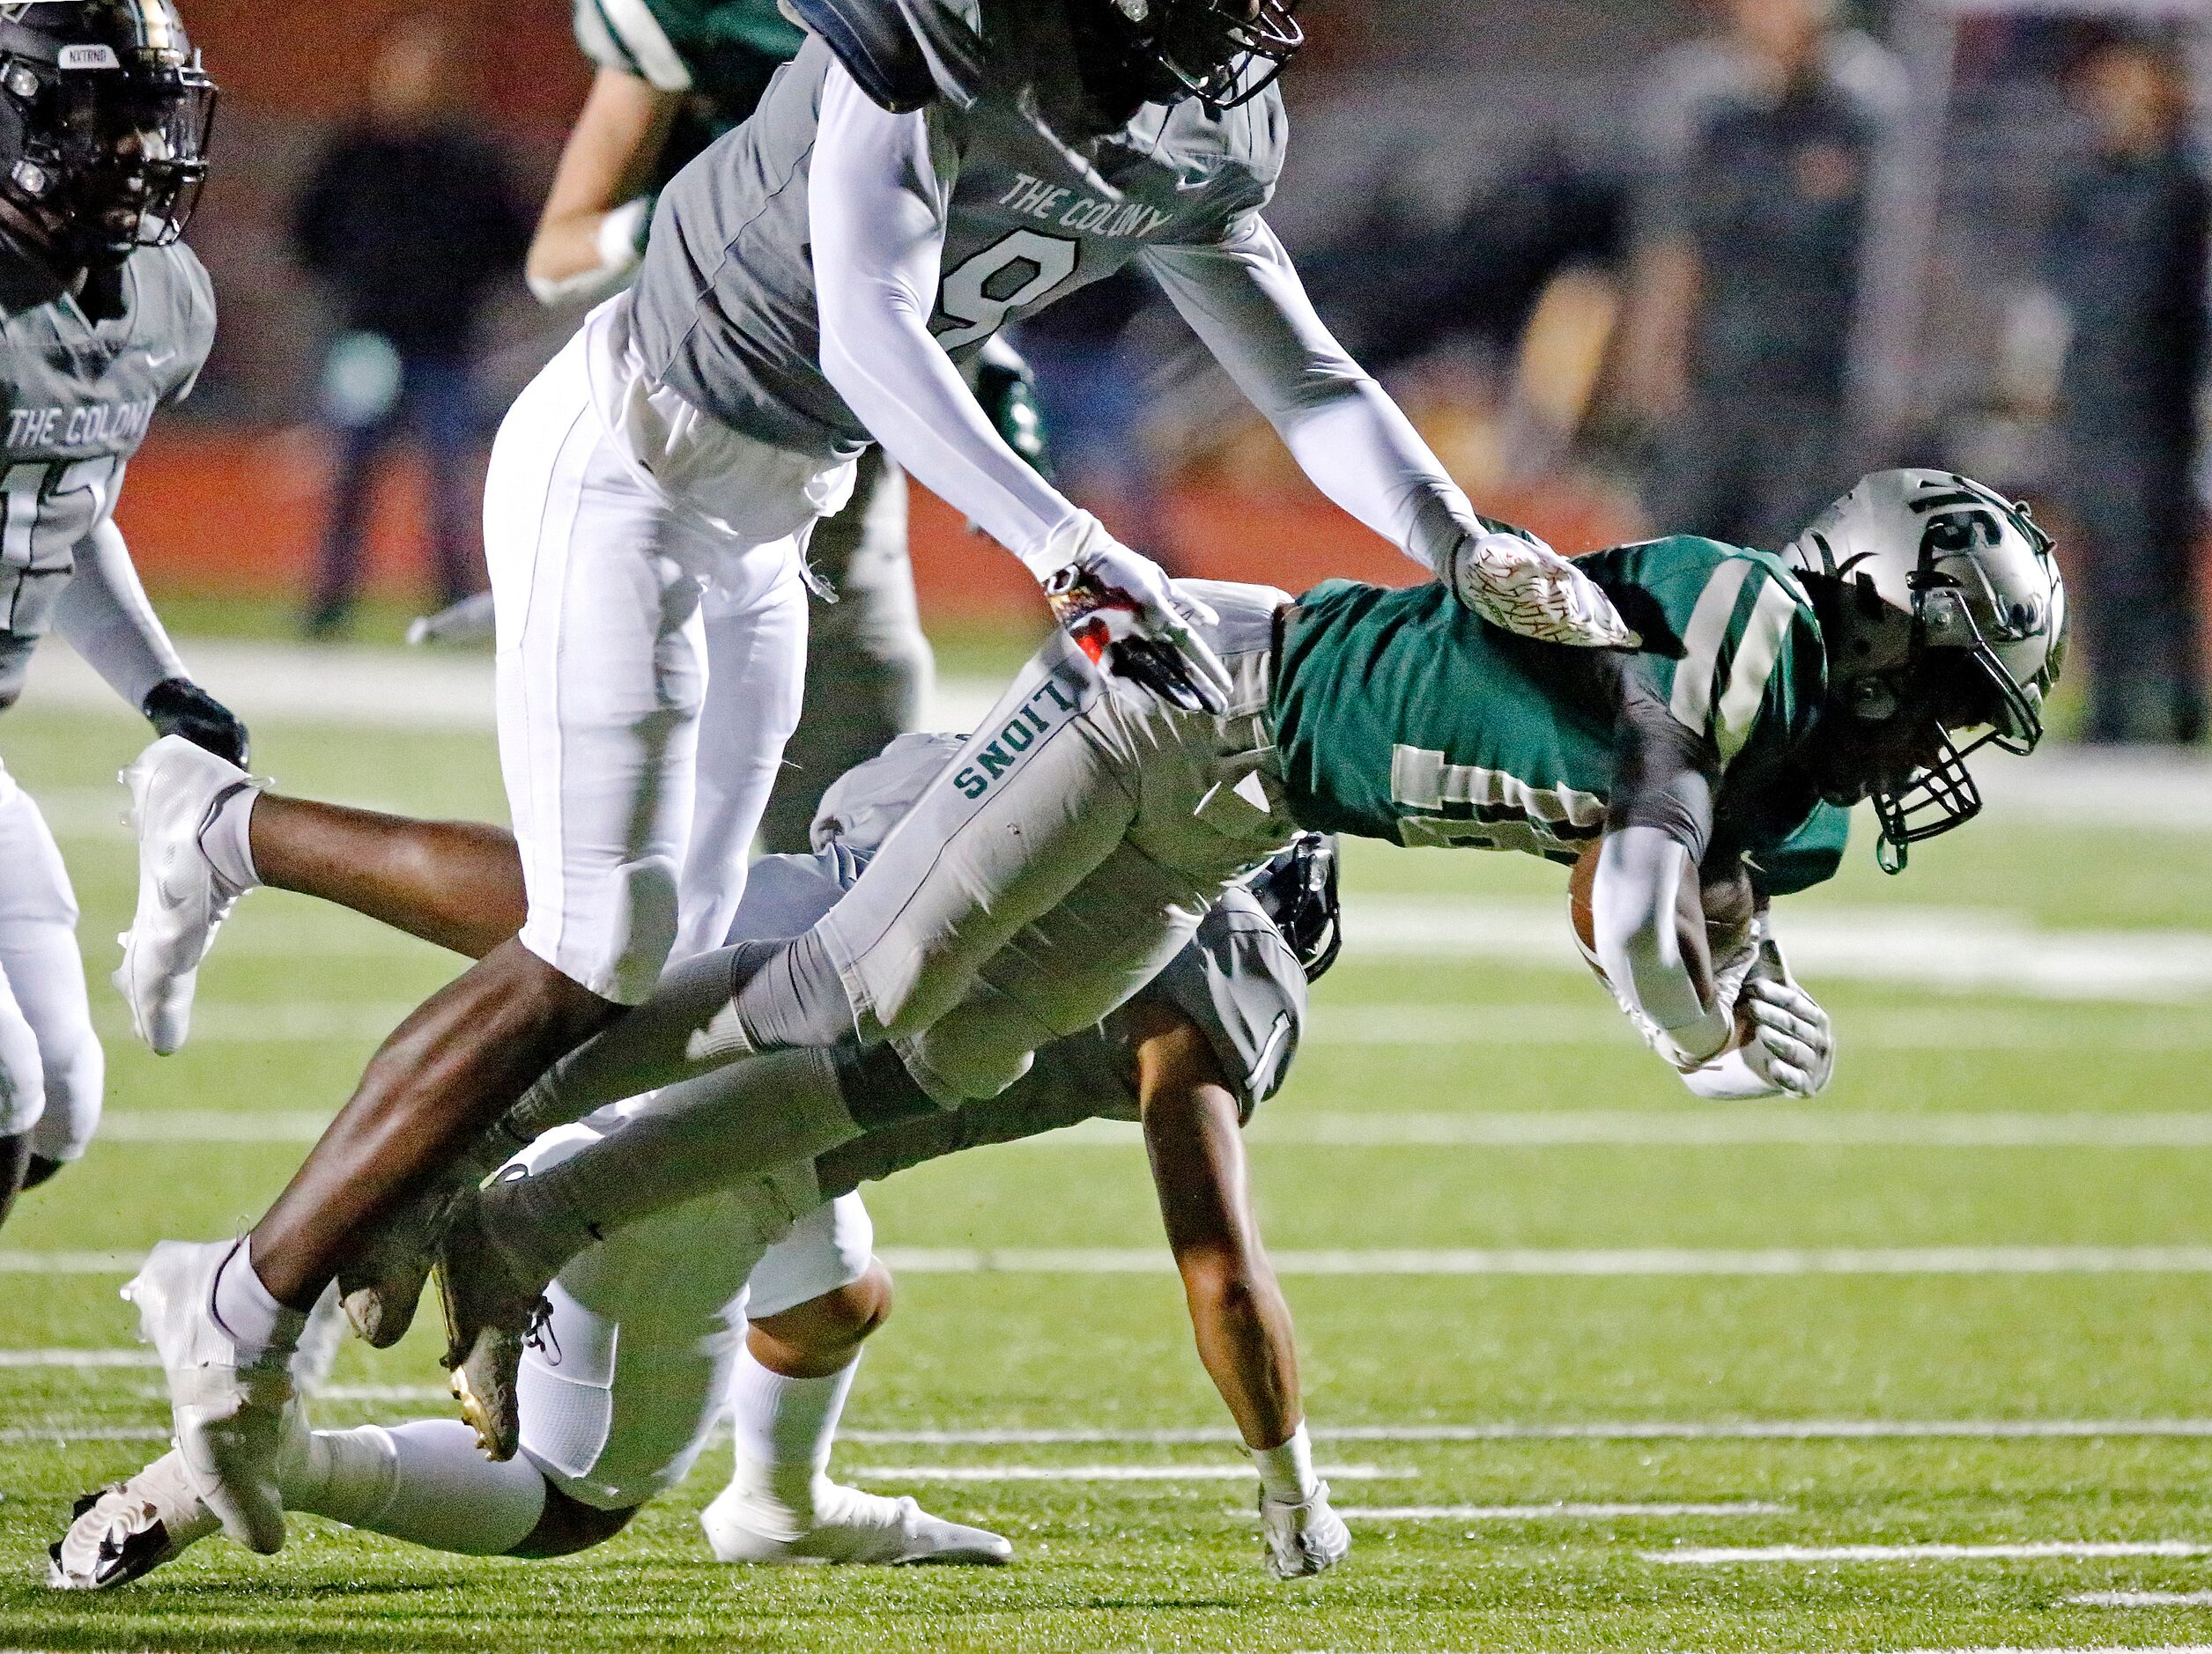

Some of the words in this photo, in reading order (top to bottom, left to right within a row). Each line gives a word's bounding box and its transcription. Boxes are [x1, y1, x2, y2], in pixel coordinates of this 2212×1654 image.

[998, 173, 1072, 219] THE
[1058, 197, 1173, 240] COLONY
[6, 408, 63, 447] THE
[66, 401, 152, 444] COLON
[953, 679, 1076, 800] LIONS
